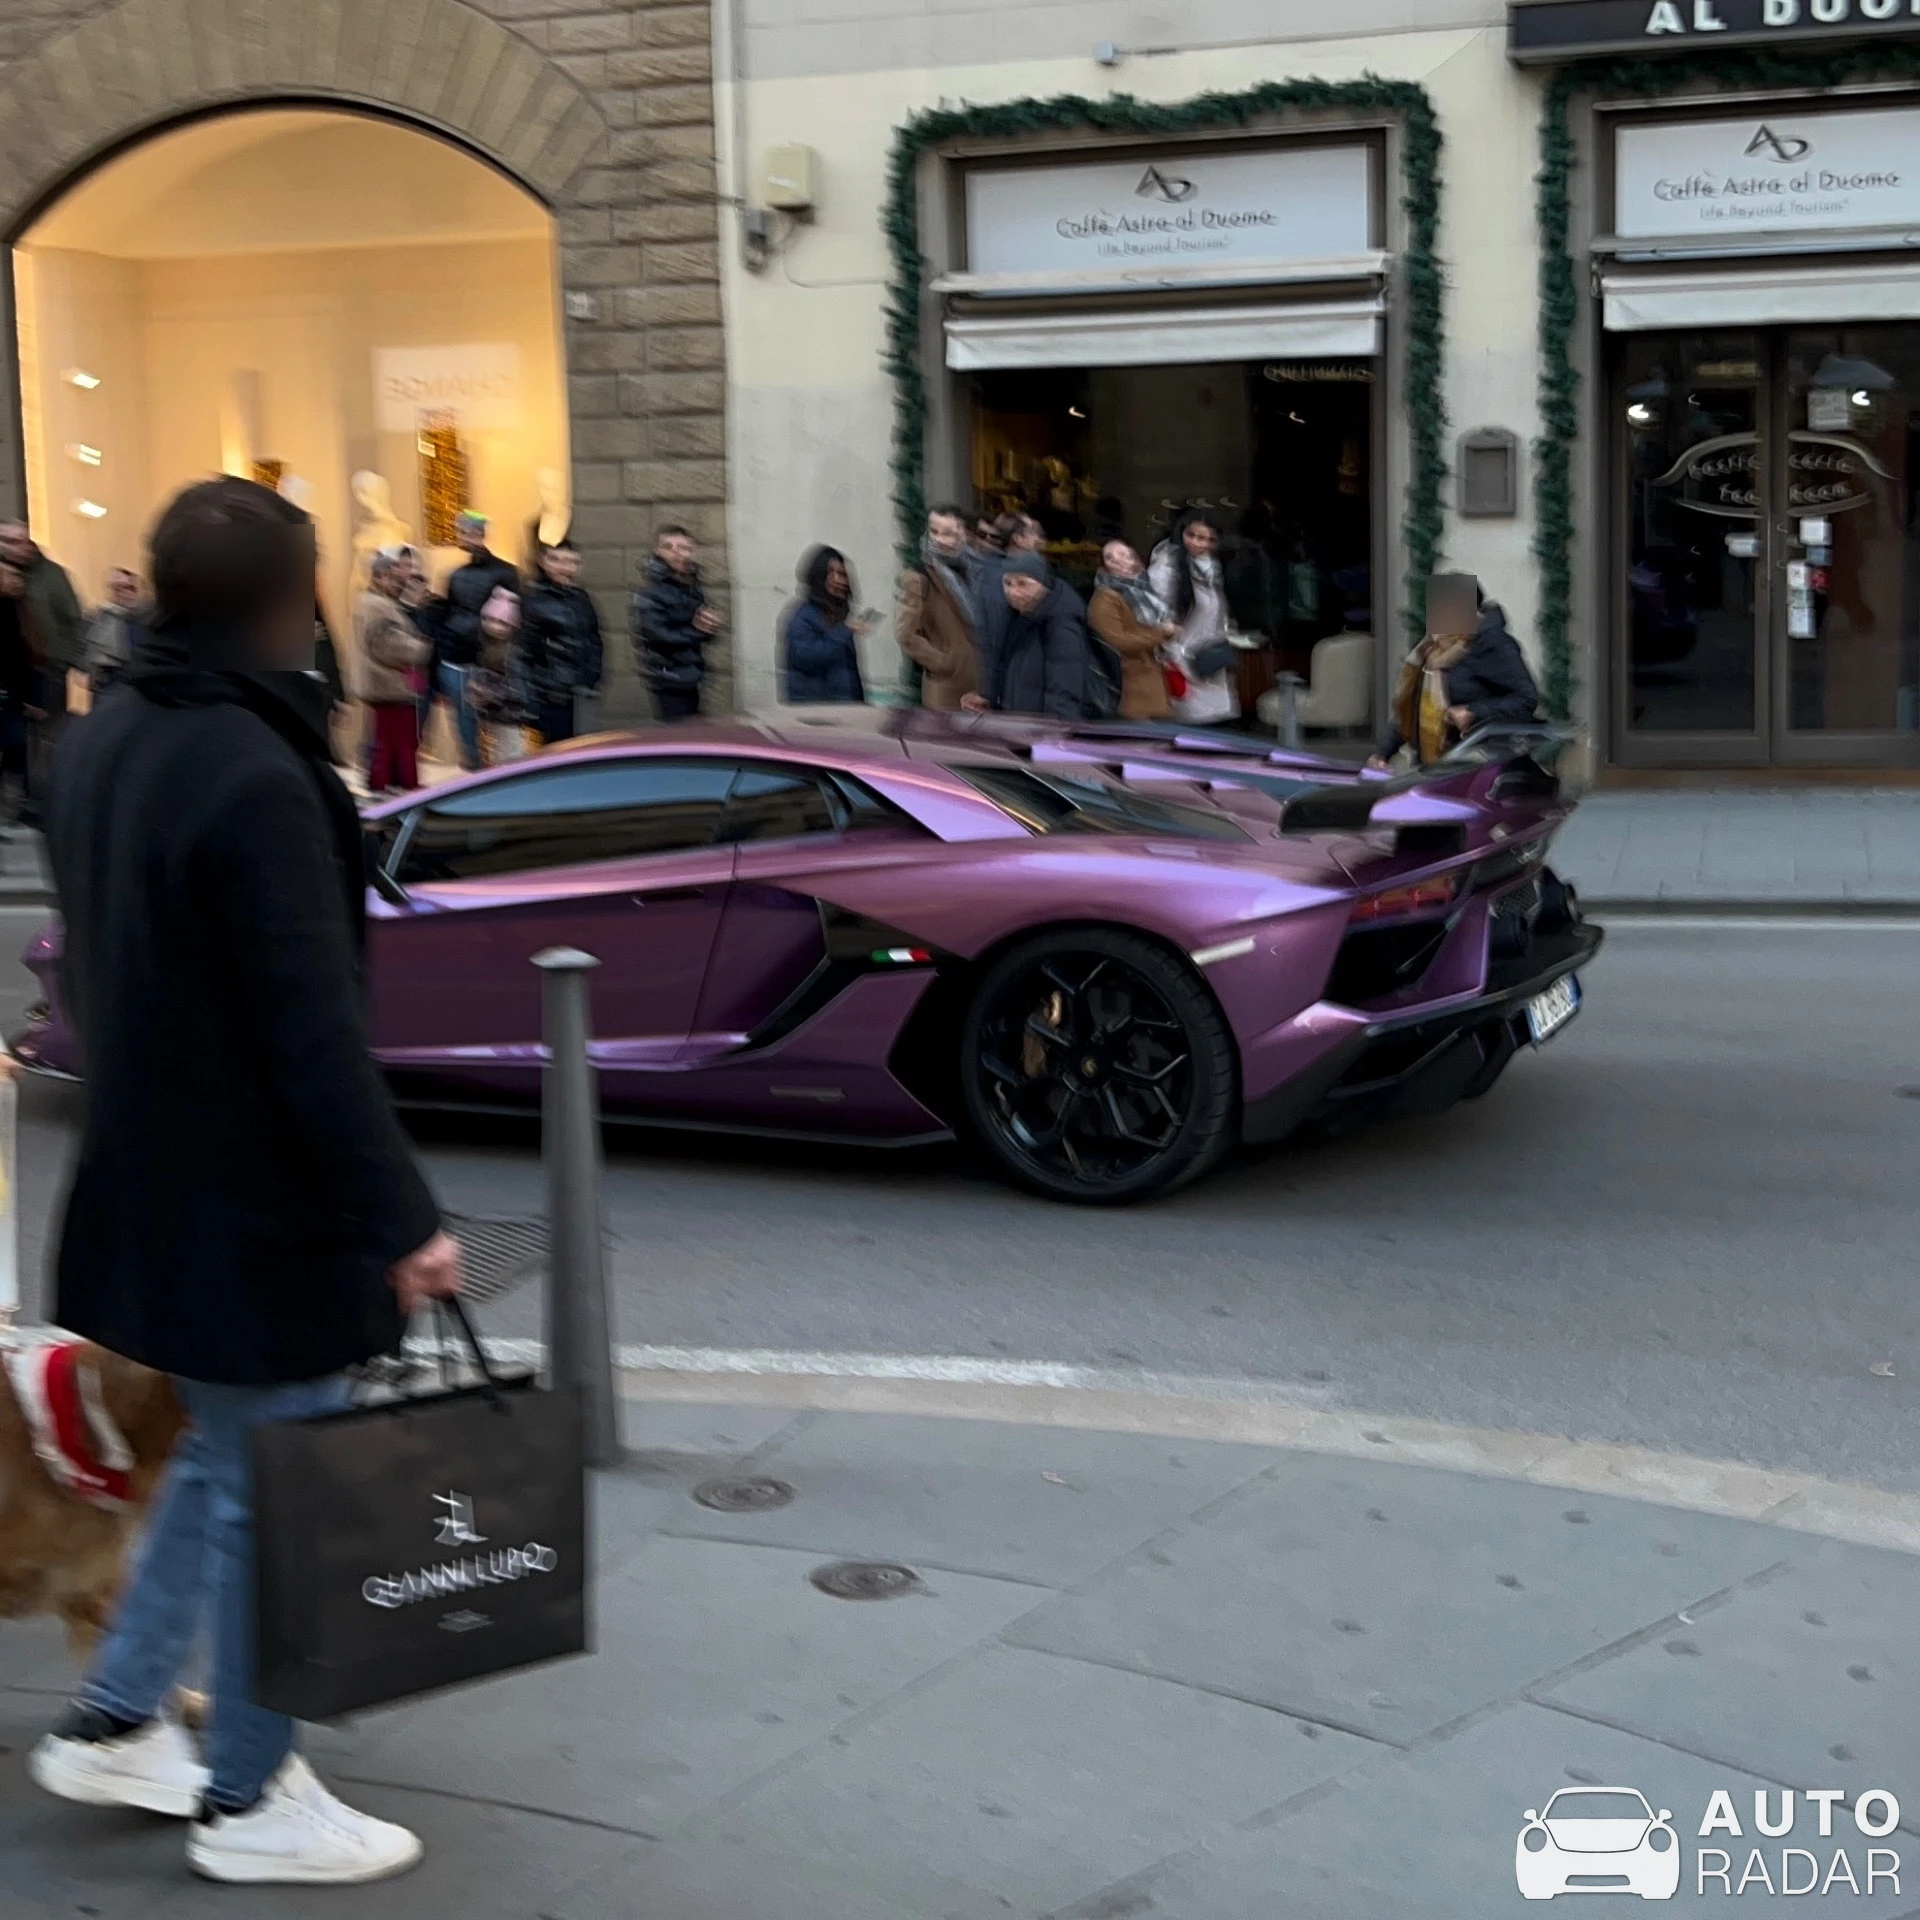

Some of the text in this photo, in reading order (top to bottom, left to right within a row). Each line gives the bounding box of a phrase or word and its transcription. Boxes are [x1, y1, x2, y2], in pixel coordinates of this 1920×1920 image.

[1645, 0, 1920, 35] AL DUO
[1653, 169, 1903, 201] Caffè Astra al Duomo
[1056, 208, 1280, 239] Caffè Astra al Duomo
[362, 1542, 558, 1608] GIANNI LUPO
